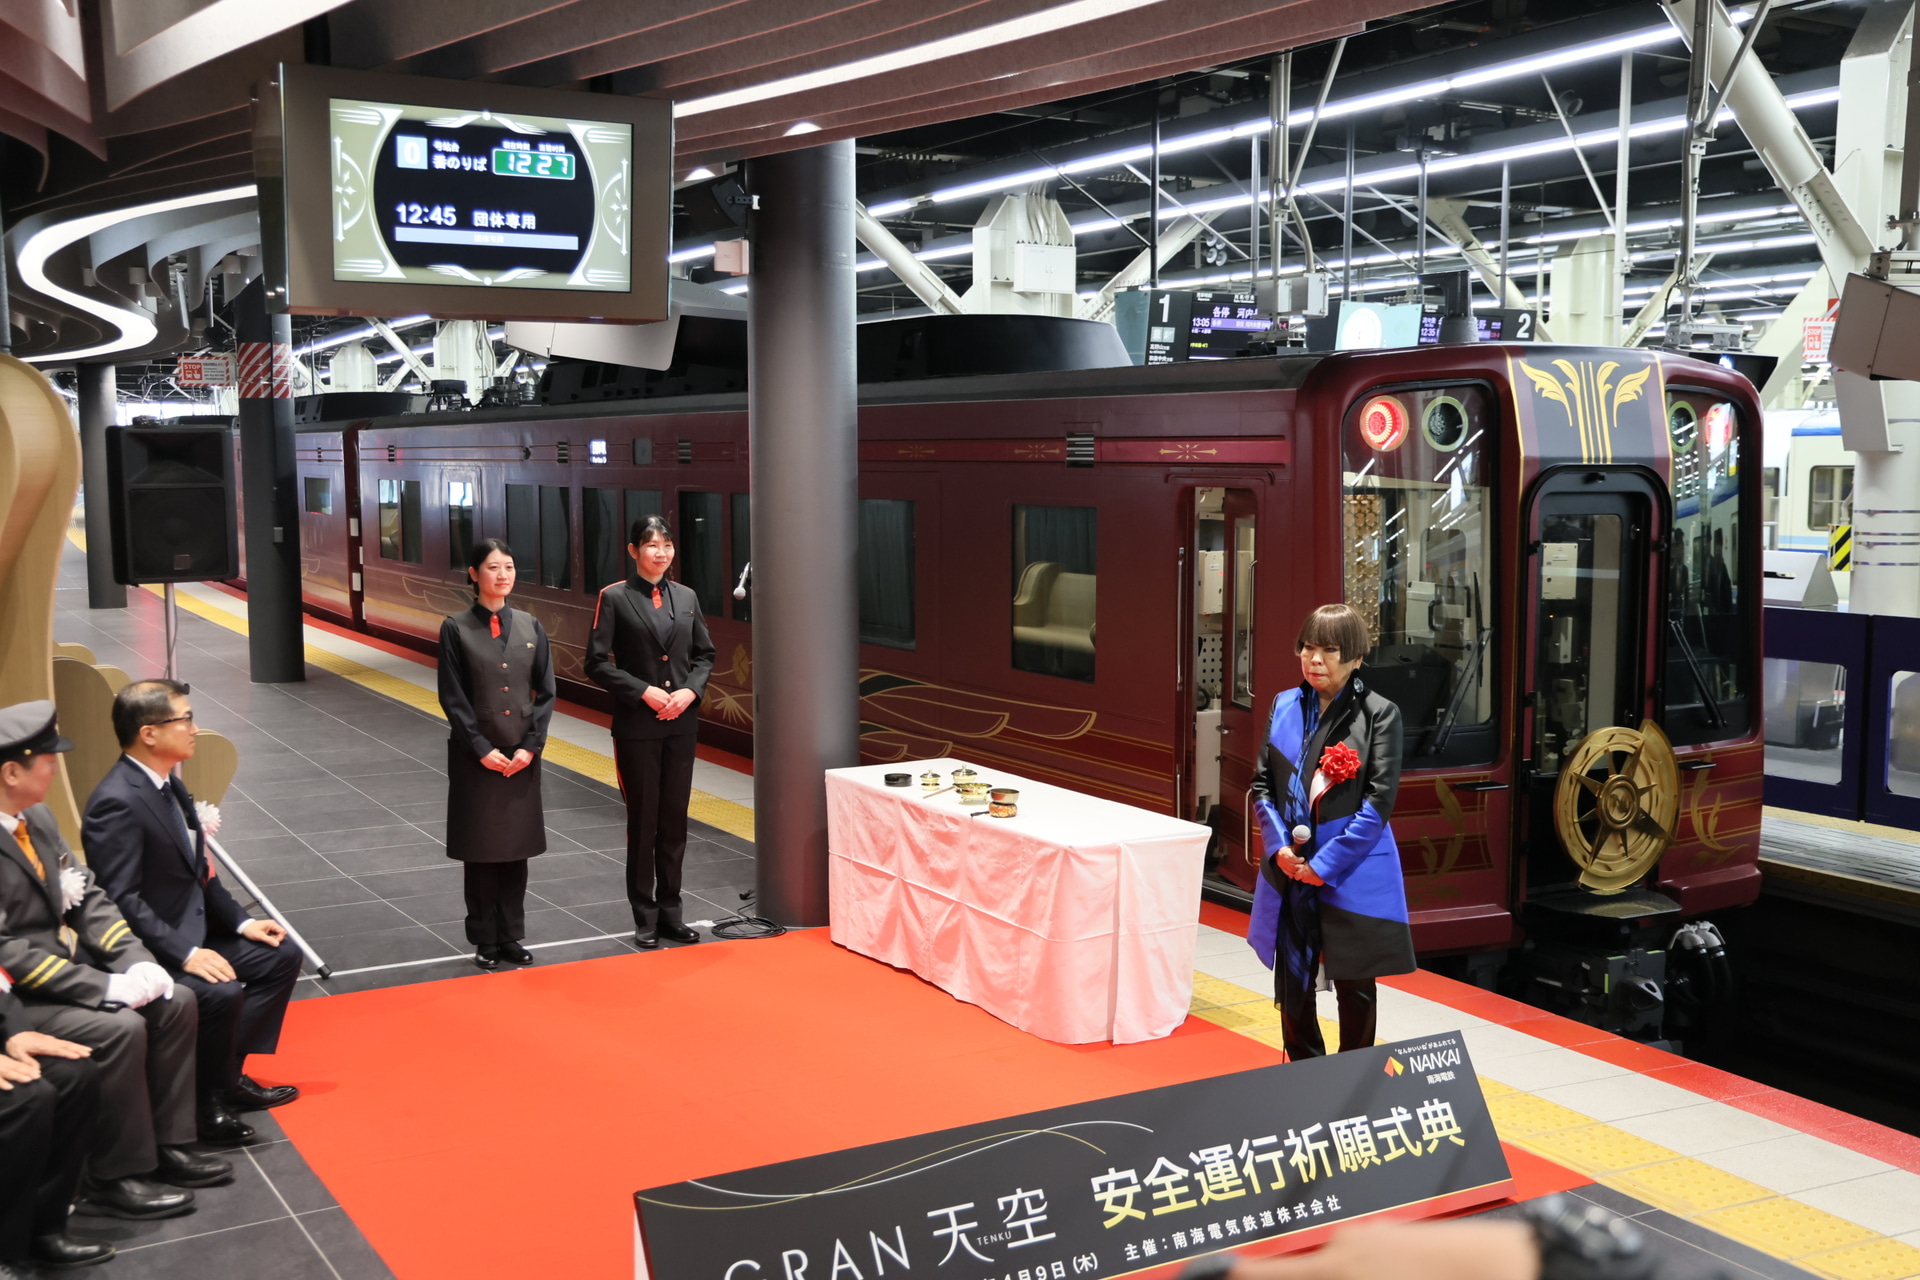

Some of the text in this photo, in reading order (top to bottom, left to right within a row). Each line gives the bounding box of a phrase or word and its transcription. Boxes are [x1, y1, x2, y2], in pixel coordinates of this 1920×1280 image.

[404, 141, 419, 165] 0
[432, 155, 488, 172] 番のりば
[396, 204, 457, 226] 12:45
[473, 211, 536, 230] 団体専用
[1158, 294, 1171, 323] 1
[1212, 306, 1231, 319] 各停
[1516, 313, 1532, 339] 2
[1409, 1047, 1461, 1074] NANKAI
[1425, 1070, 1456, 1085] 南海電鉄
[1090, 1098, 1466, 1229] 安全運行祈願式典
[927, 1187, 1057, 1267] 天空
[976, 1230, 1012, 1247] TENKU
